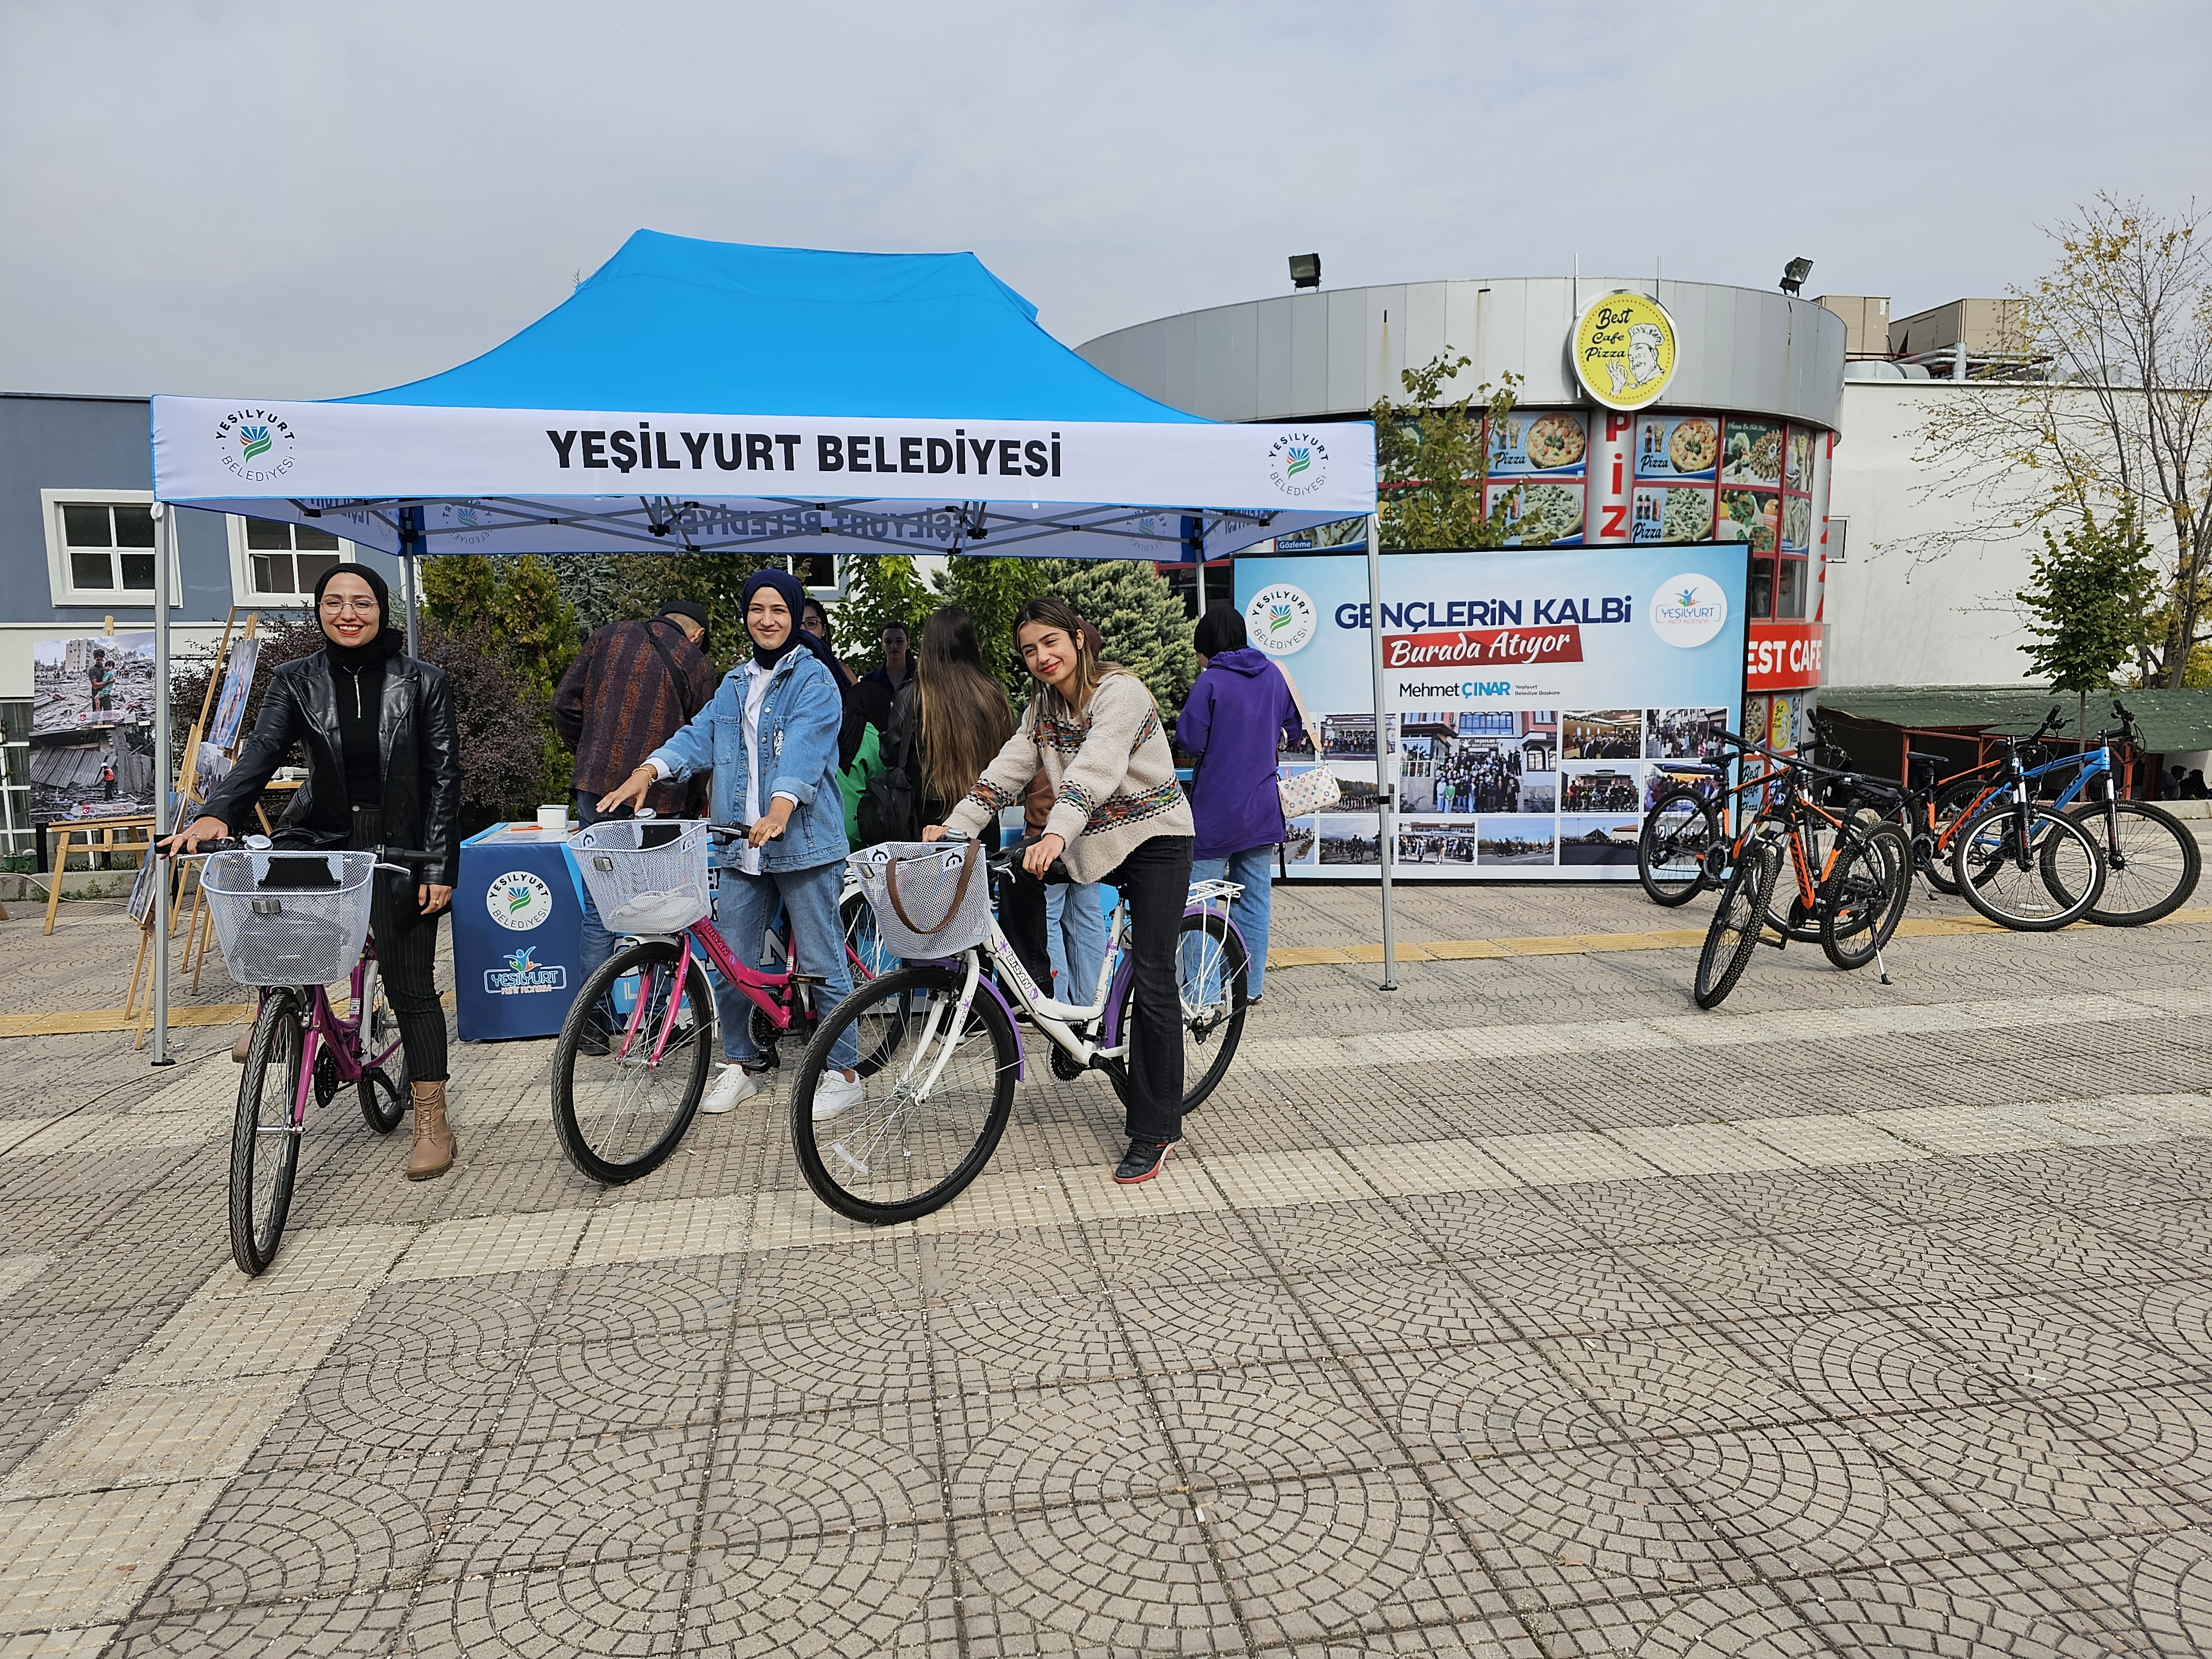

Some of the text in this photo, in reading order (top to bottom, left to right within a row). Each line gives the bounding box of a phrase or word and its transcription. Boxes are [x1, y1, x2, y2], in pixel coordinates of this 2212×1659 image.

[1595, 308, 1633, 330] Best
[1592, 332, 1624, 344] Cafe
[1585, 347, 1626, 362] Pizza
[546, 421, 1061, 477] YEŞİLYURT BELEDİYESİ
[1495, 452, 1525, 469] Pizza
[1641, 455, 1668, 472] Pizza
[1632, 522, 1662, 542] Pizza
[1279, 540, 1311, 550] Gözleme
[1390, 632, 1570, 666] Burada Atıyor
[1790, 640, 1822, 672] CAFE
[1400, 682, 1511, 699] Mehmet ÇINAR
[1743, 764, 1761, 782] Best
[1743, 785, 1759, 798] Cafe
[1742, 801, 1757, 811] Pizza
[704, 924, 730, 956] BISAN
[1006, 953, 1032, 989] BISAN
